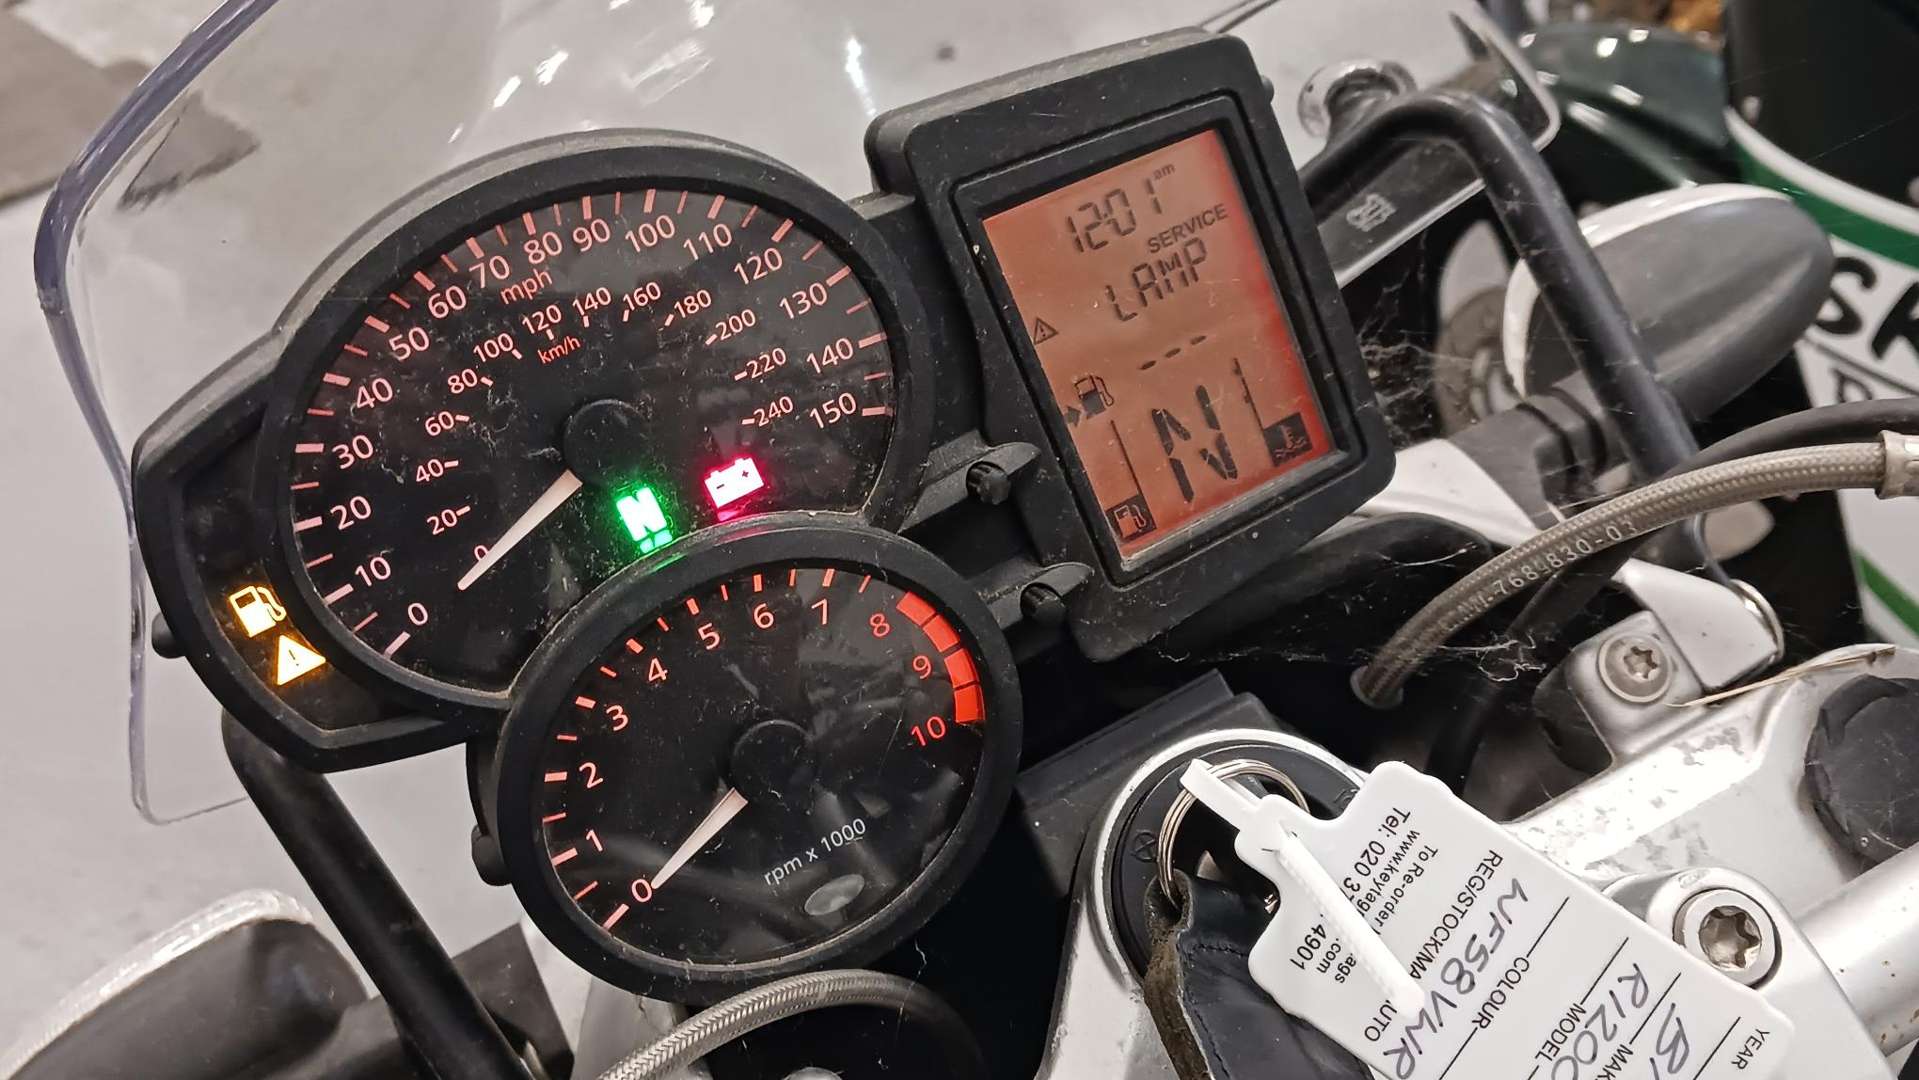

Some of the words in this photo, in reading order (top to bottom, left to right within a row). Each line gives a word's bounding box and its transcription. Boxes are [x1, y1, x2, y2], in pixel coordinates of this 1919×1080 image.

[1153, 163, 1175, 181] am
[572, 219, 611, 252] 90
[625, 215, 675, 253] 100
[683, 223, 732, 261] 110
[1148, 203, 1228, 254] SERVICE
[523, 232, 563, 264] 80
[468, 255, 511, 289] 70
[734, 247, 783, 285] 120
[1105, 237, 1207, 322] LAMP
[427, 285, 467, 319] 60
[500, 268, 553, 305] mph
[572, 287, 612, 316] 140
[622, 282, 661, 313] 160
[779, 282, 827, 319] 130
[521, 305, 562, 335] 120
[672, 290, 712, 319] 180
[715, 309, 756, 341] 200
[388, 326, 430, 361] 50
[472, 333, 514, 363] 100
[537, 335, 582, 365] km/h
[806, 338, 854, 374] 140
[746, 348, 787, 380] 220
[354, 378, 393, 411] 40
[447, 368, 478, 394] 80
[424, 411, 455, 437] 60
[752, 396, 794, 427] 240
[809, 392, 857, 429] 150
[331, 435, 374, 470] 30
[1151, 385, 1238, 503] N
[415, 459, 444, 484] 40
[330, 495, 372, 531] 20
[426, 508, 458, 536] 20
[615, 486, 668, 542] N
[354, 556, 392, 587] 10
[407, 602, 429, 626] 0
[752, 603, 775, 630] 6
[811, 598, 829, 625] 7
[869, 613, 891, 638] 8
[697, 622, 721, 650] 5
[646, 657, 668, 685] 4
[912, 654, 933, 680] 9
[605, 704, 629, 732] 3
[910, 716, 946, 747] 10
[578, 761, 603, 789] 2
[1377, 807, 1411, 838] Tel:
[585, 829, 602, 852] 1
[763, 856, 803, 886] rpm
[805, 847, 819, 862] x
[820, 818, 866, 852] 1000
[1417, 844, 1439, 862] To
[1353, 840, 1386, 877] 020
[630, 878, 654, 902] 0
[1374, 862, 1425, 928] Re-order
[1289, 924, 1328, 971] 4901
[1471, 957, 1530, 1030] COLOUR
[1533, 1002, 1588, 1062] MODEL
[1595, 1043, 1634, 1080] MAK
[1731, 1028, 1771, 1070] YEAR
